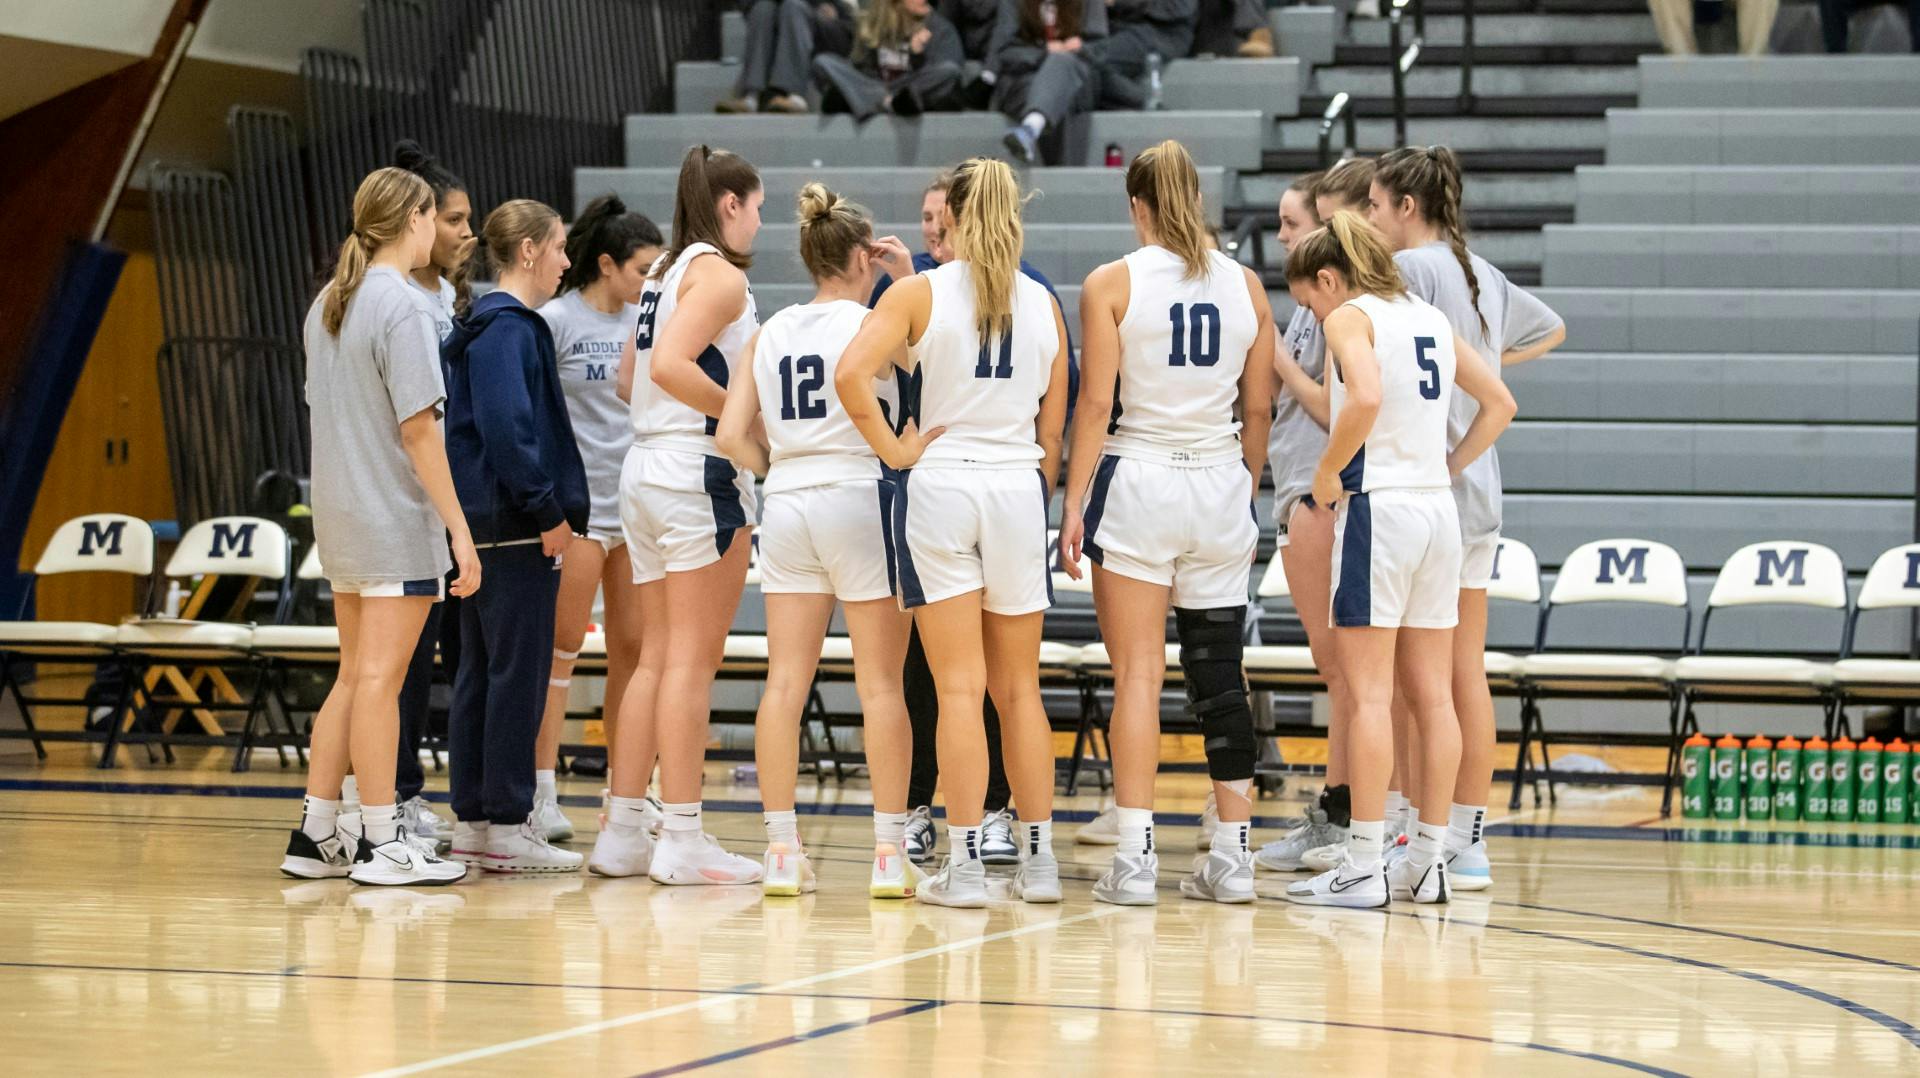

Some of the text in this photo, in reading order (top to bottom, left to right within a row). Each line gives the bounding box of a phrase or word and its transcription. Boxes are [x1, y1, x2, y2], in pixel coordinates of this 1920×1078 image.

[1168, 303, 1221, 366] 10
[975, 314, 1013, 378] 11
[586, 364, 607, 380] M
[1414, 337, 1441, 399] 5
[779, 355, 827, 420] 12
[77, 521, 127, 556] M
[207, 523, 259, 558] M
[1596, 548, 1649, 583] M
[1754, 550, 1809, 586] M
[1685, 758, 1697, 779] G
[1717, 759, 1733, 779] G
[1751, 760, 1769, 781] G
[1777, 760, 1792, 780] G
[1809, 761, 1826, 782] G
[1832, 761, 1847, 782] G
[1859, 762, 1875, 782] G
[1884, 763, 1900, 783] G
[1885, 797, 1902, 813] 15
